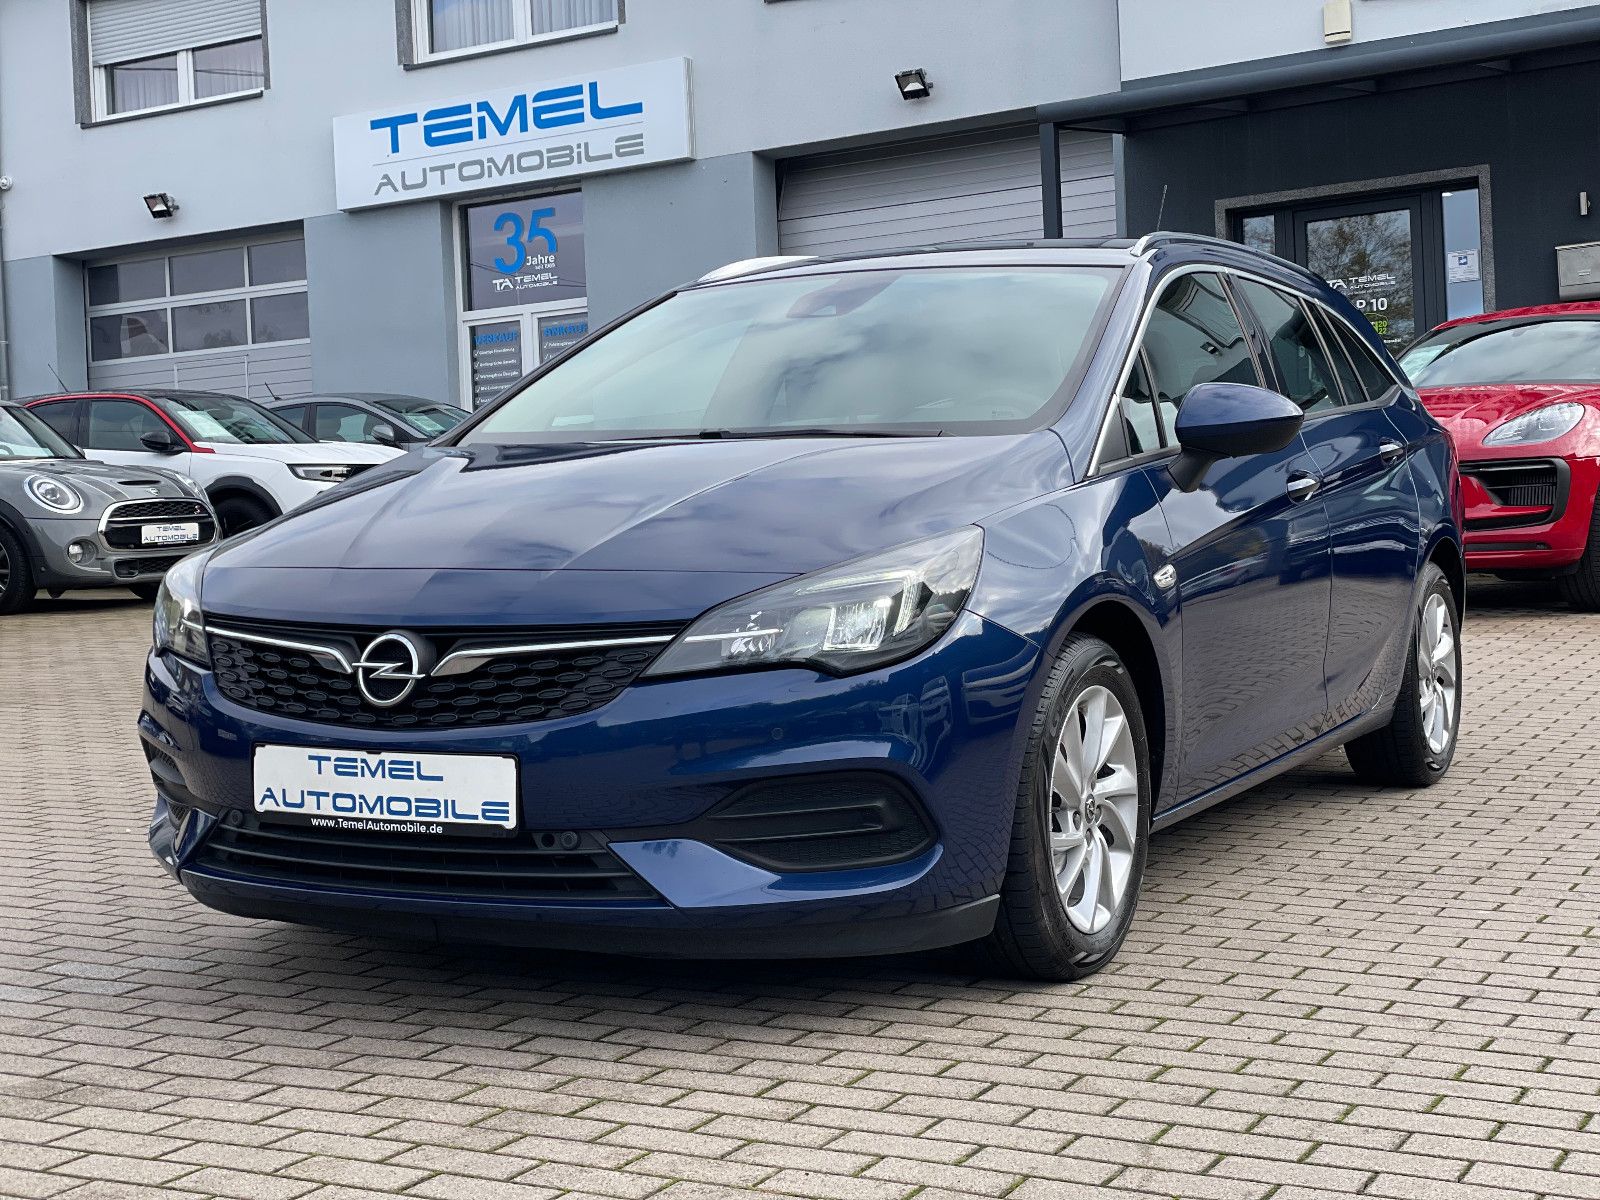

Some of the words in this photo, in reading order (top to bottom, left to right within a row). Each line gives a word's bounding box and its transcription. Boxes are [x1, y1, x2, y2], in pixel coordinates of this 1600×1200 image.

[370, 81, 643, 154] TEMEL
[493, 206, 558, 276] 35
[526, 254, 555, 266] Jahre
[515, 272, 558, 283] TEMEL
[1348, 273, 1396, 284] TEMEL
[492, 278, 514, 291] TA
[1349, 281, 1396, 290] AUTOMOBILE
[1370, 298, 1388, 311] 10
[474, 331, 518, 345] VERKAUF
[144, 533, 197, 541] AUTOMOBILE
[307, 754, 444, 782] TEMEL
[259, 787, 510, 822] AUTOMOBILE
[310, 817, 443, 834] www.TemelAutomobile.de
